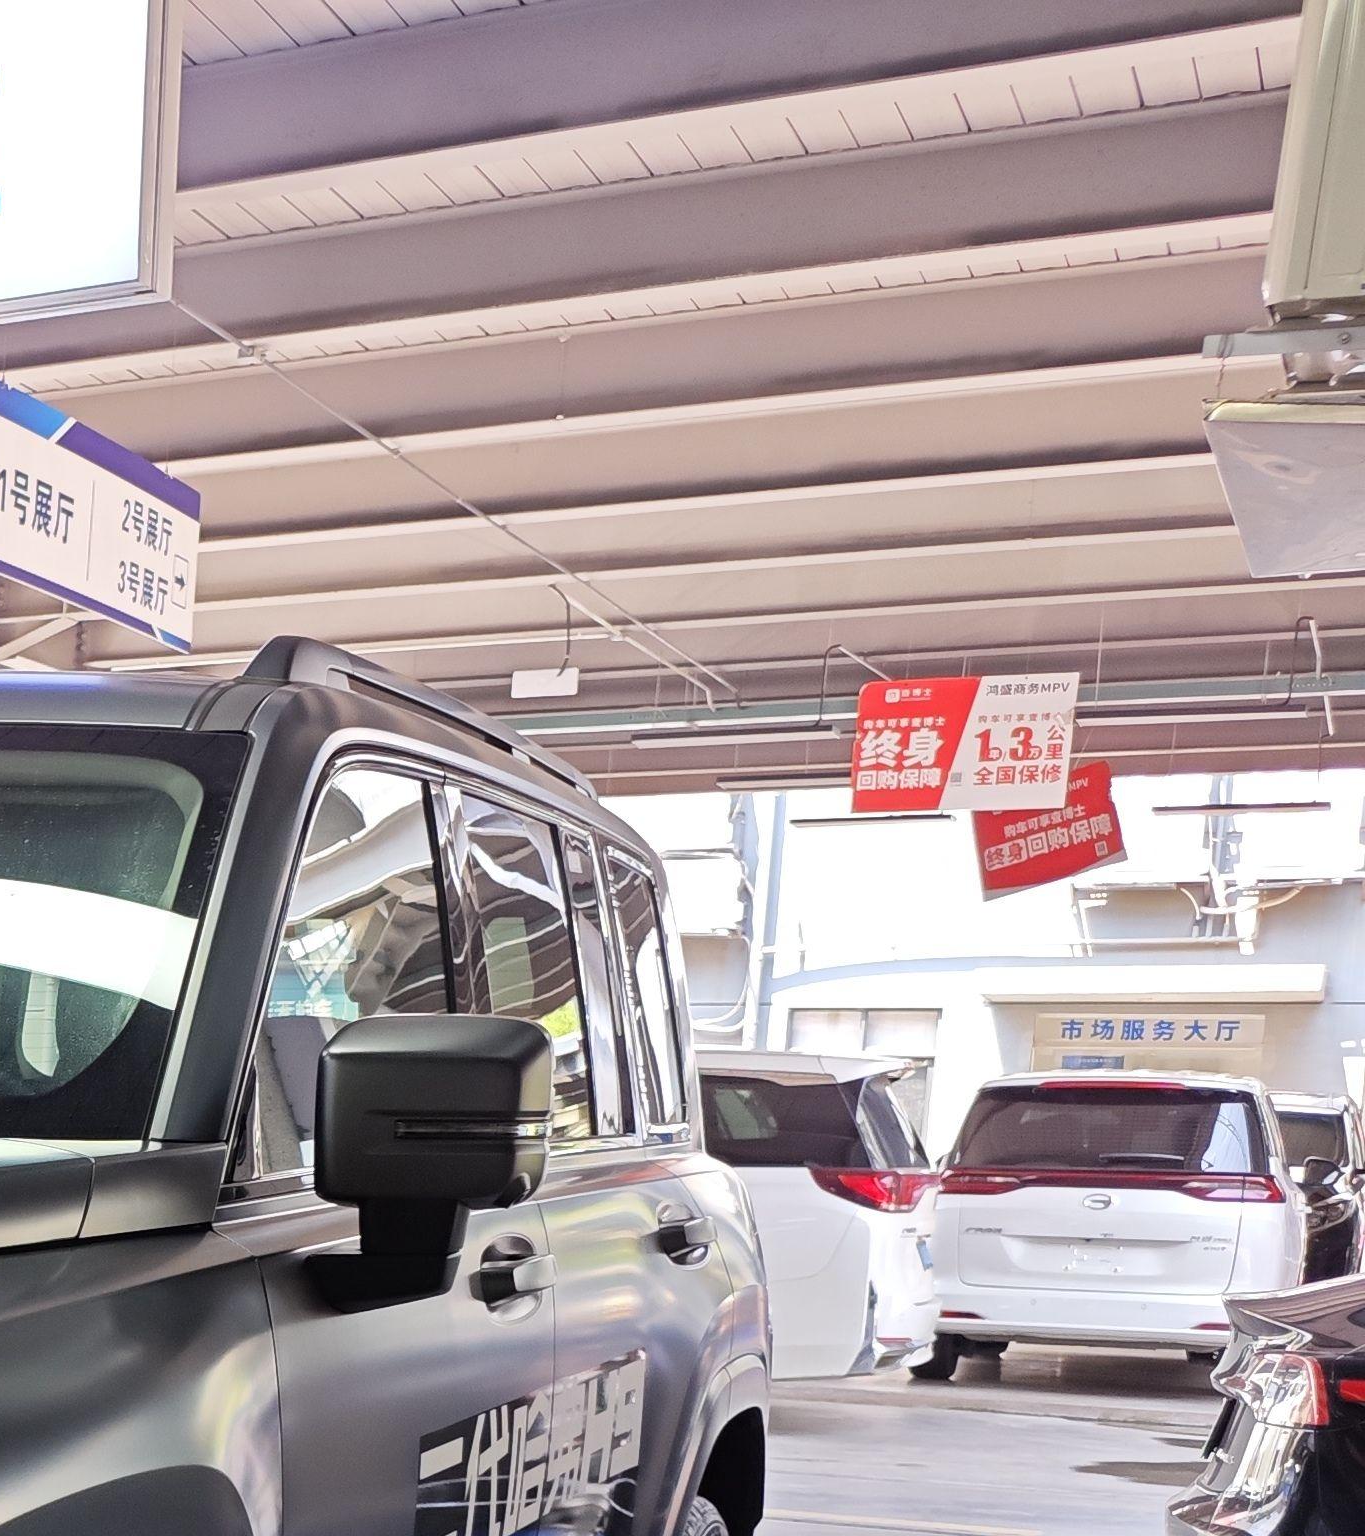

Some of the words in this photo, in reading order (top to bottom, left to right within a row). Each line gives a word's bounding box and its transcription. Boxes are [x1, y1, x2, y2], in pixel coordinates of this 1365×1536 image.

[122, 498, 173, 556] 2号展厅
[117, 560, 169, 615] 3号展厅
[859, 728, 945, 767] 终身
[856, 768, 941, 791] 回购保障
[973, 763, 1063, 786] 全国保修
[1060, 1018, 1241, 1042] 市场服务大厅
